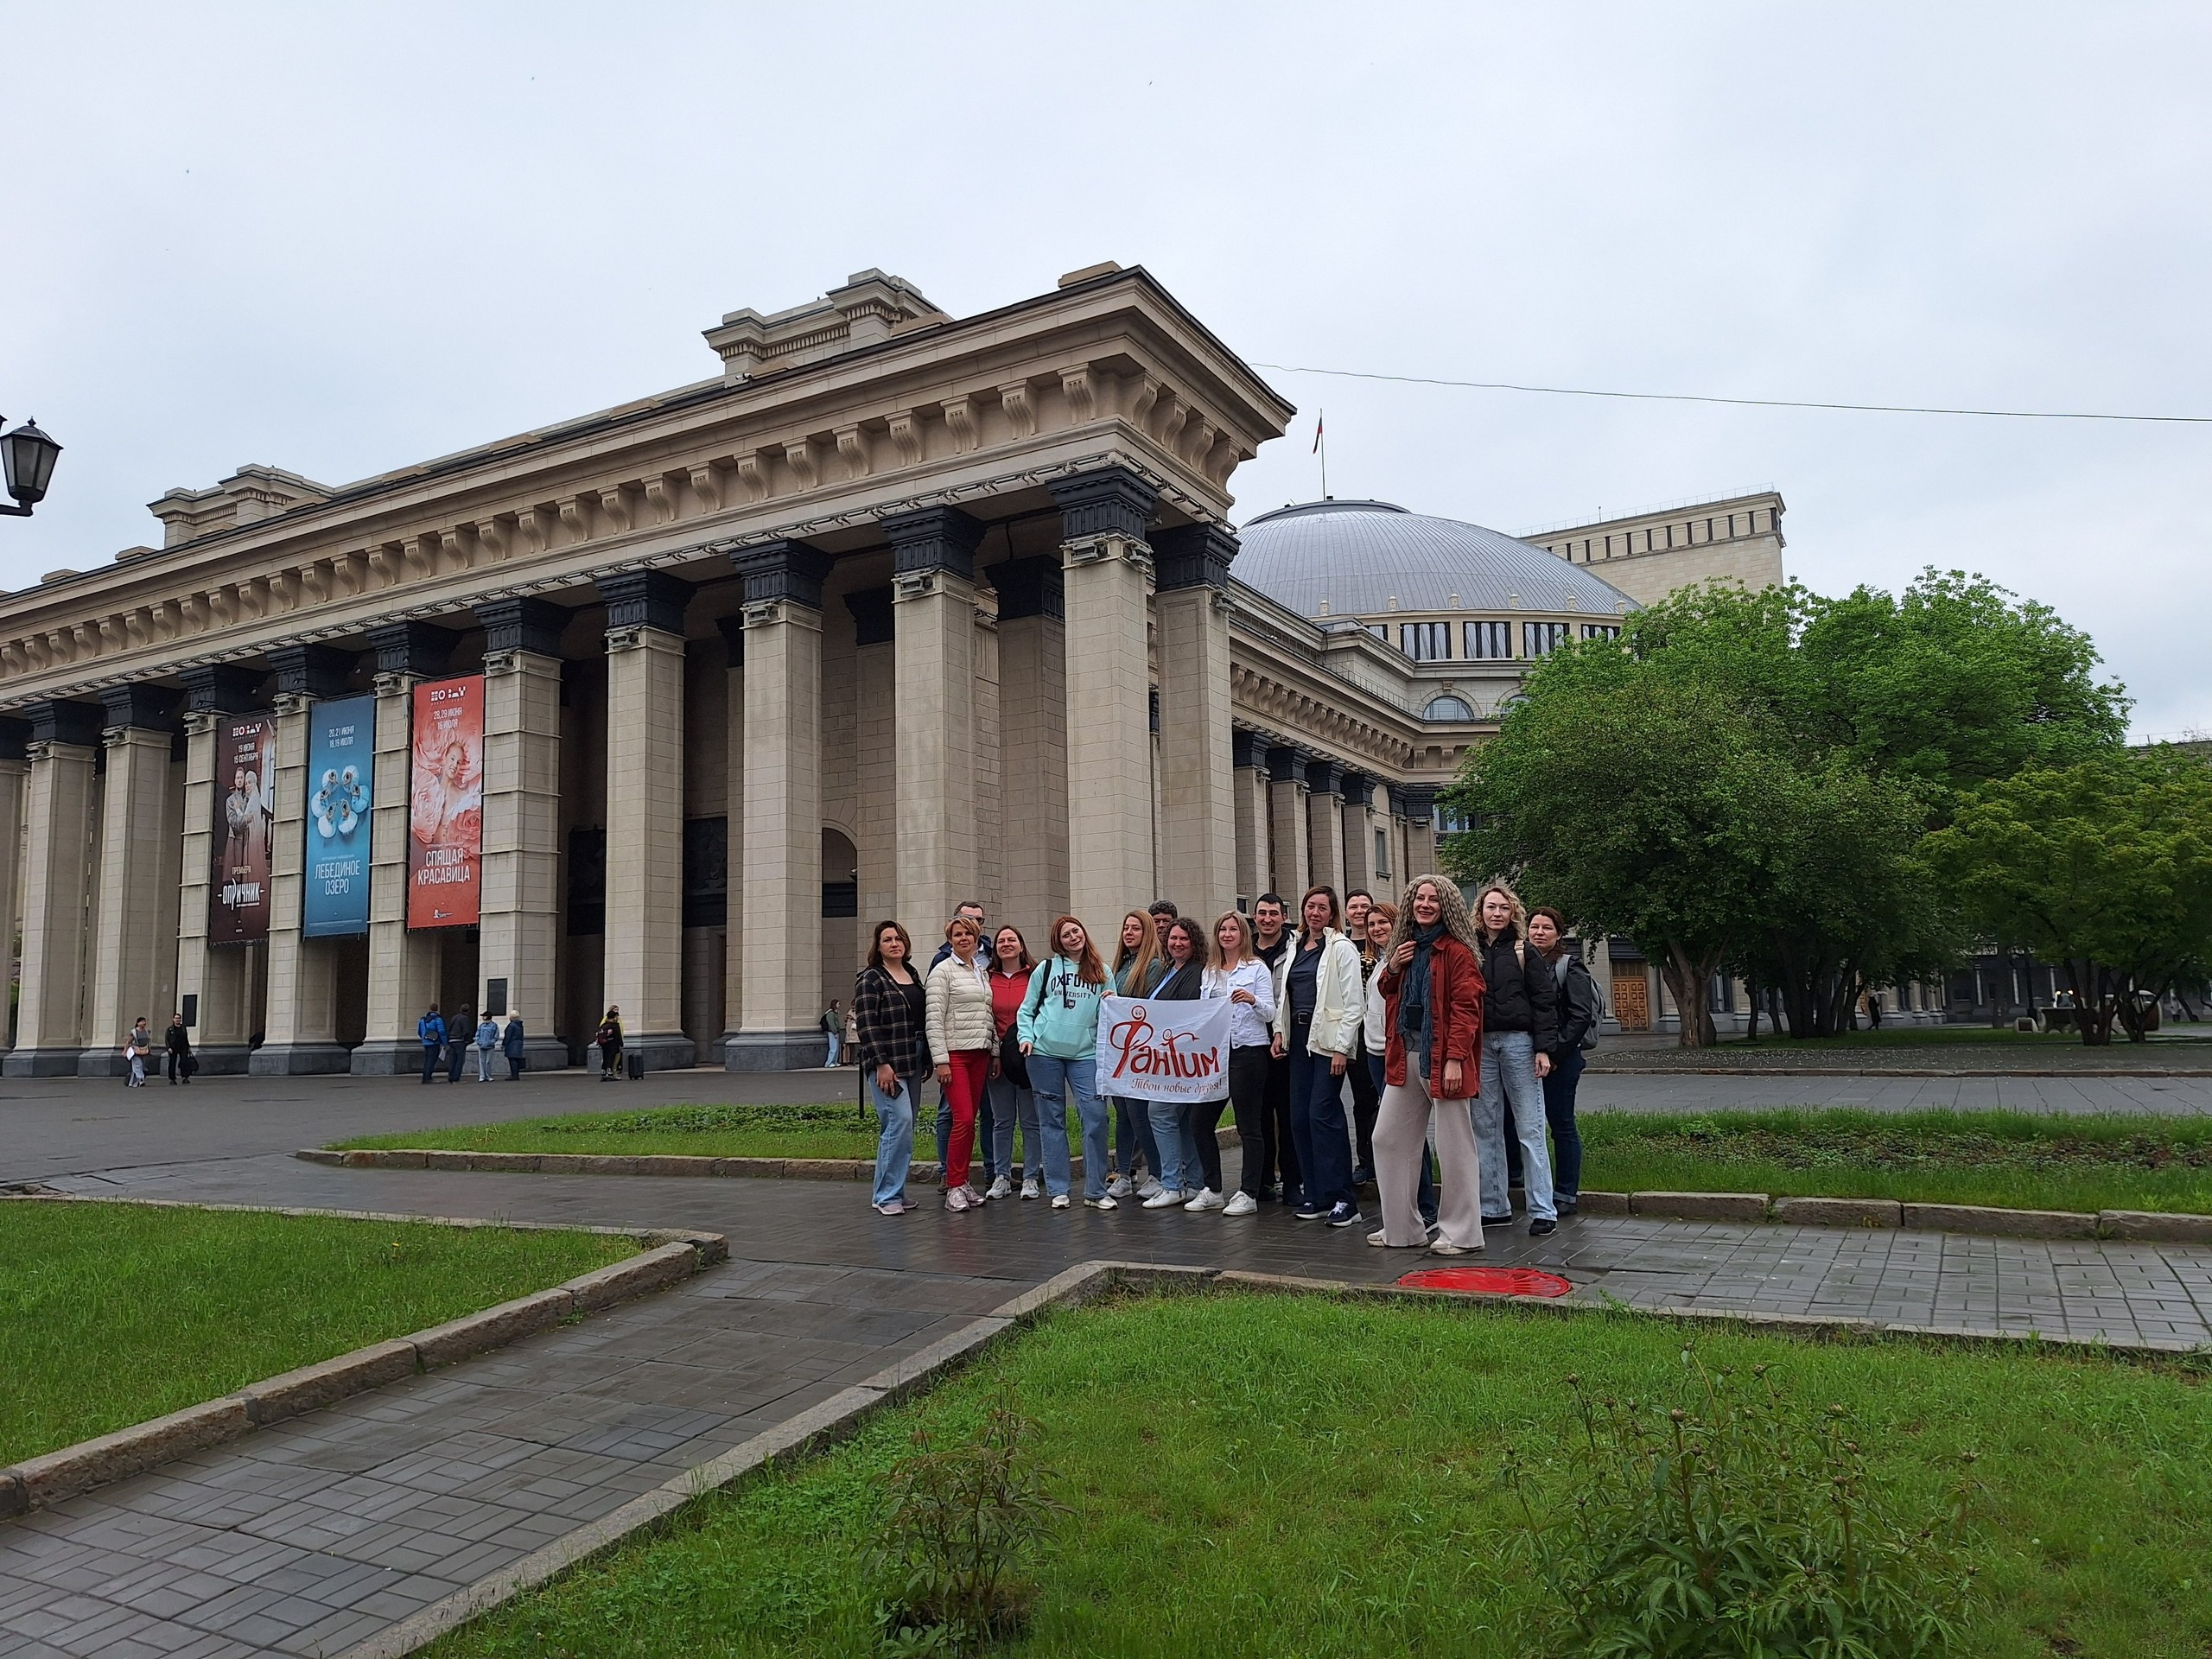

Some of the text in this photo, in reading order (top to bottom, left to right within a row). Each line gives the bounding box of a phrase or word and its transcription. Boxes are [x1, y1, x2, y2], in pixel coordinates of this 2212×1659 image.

[425, 848, 464, 868] СПЯЩАЯ
[314, 860, 360, 880] ЛЕБЕДИНОЕ
[417, 865, 471, 886] КРАСАВИЦА
[325, 878, 350, 896] ОЗЕРО
[1054, 990, 1091, 1000] UNVERSITY
[1131, 1077, 1160, 1092] Твои
[1163, 1081, 1192, 1094] новые
